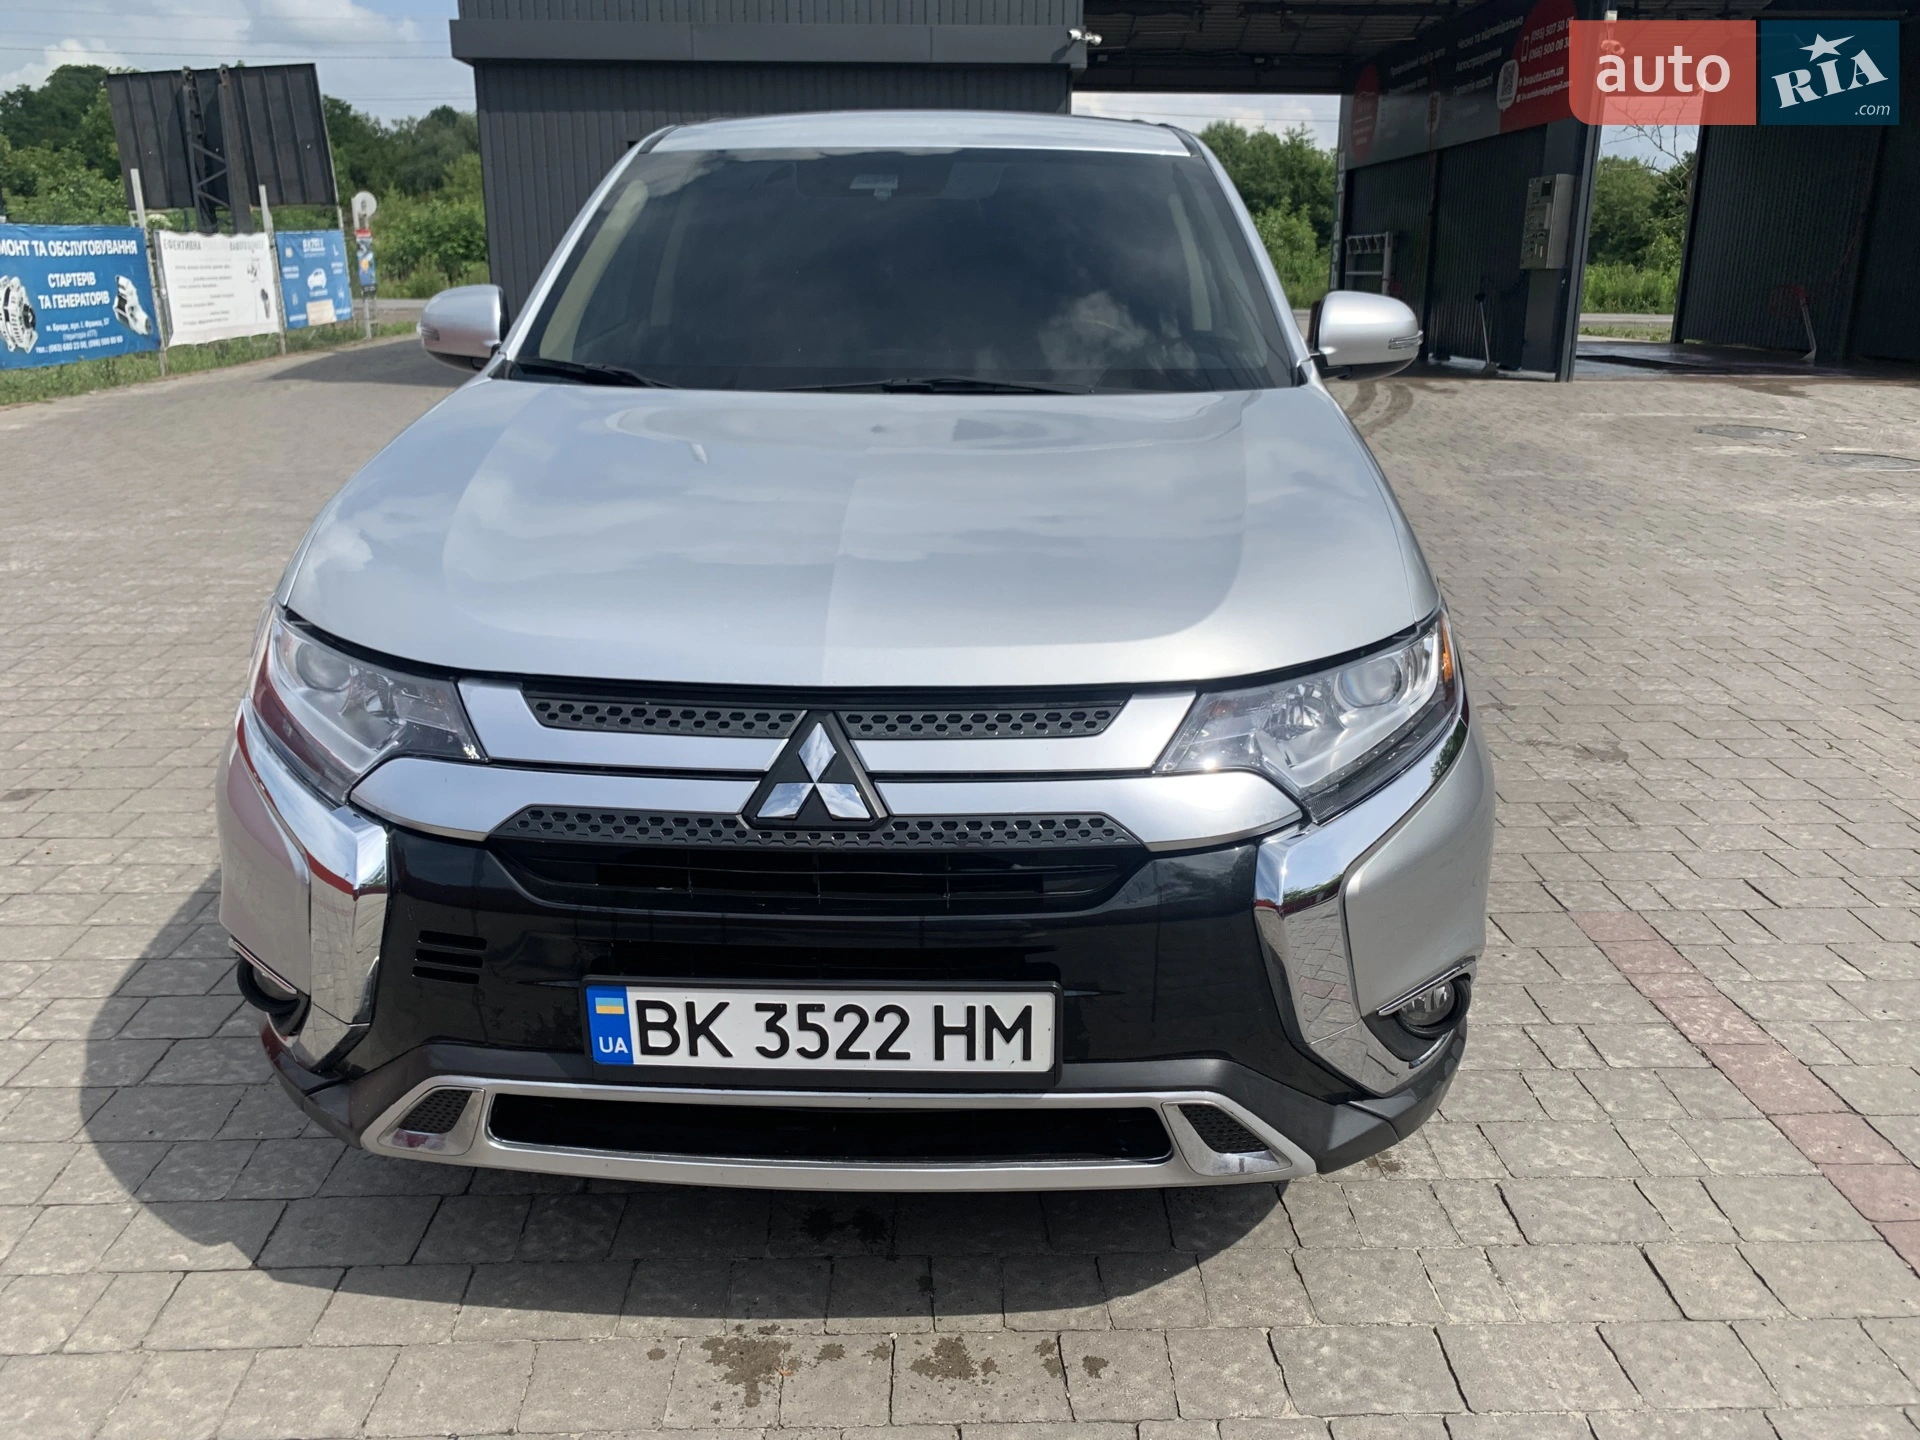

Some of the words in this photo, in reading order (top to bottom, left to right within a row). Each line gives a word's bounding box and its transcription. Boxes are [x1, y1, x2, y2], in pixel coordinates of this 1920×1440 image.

[31, 240, 48, 257] ТА
[48, 239, 138, 257] ОБСЛУГОВУВАННЯ
[48, 272, 96, 288] СТАРТЕРІВ
[38, 294, 52, 309] ТА
[52, 290, 110, 309] ГЕНЕРАТОРІВ
[635, 999, 734, 1059] BK
[755, 1002, 912, 1061] 3522
[934, 1004, 1033, 1062] HM
[599, 1037, 630, 1054] UA
